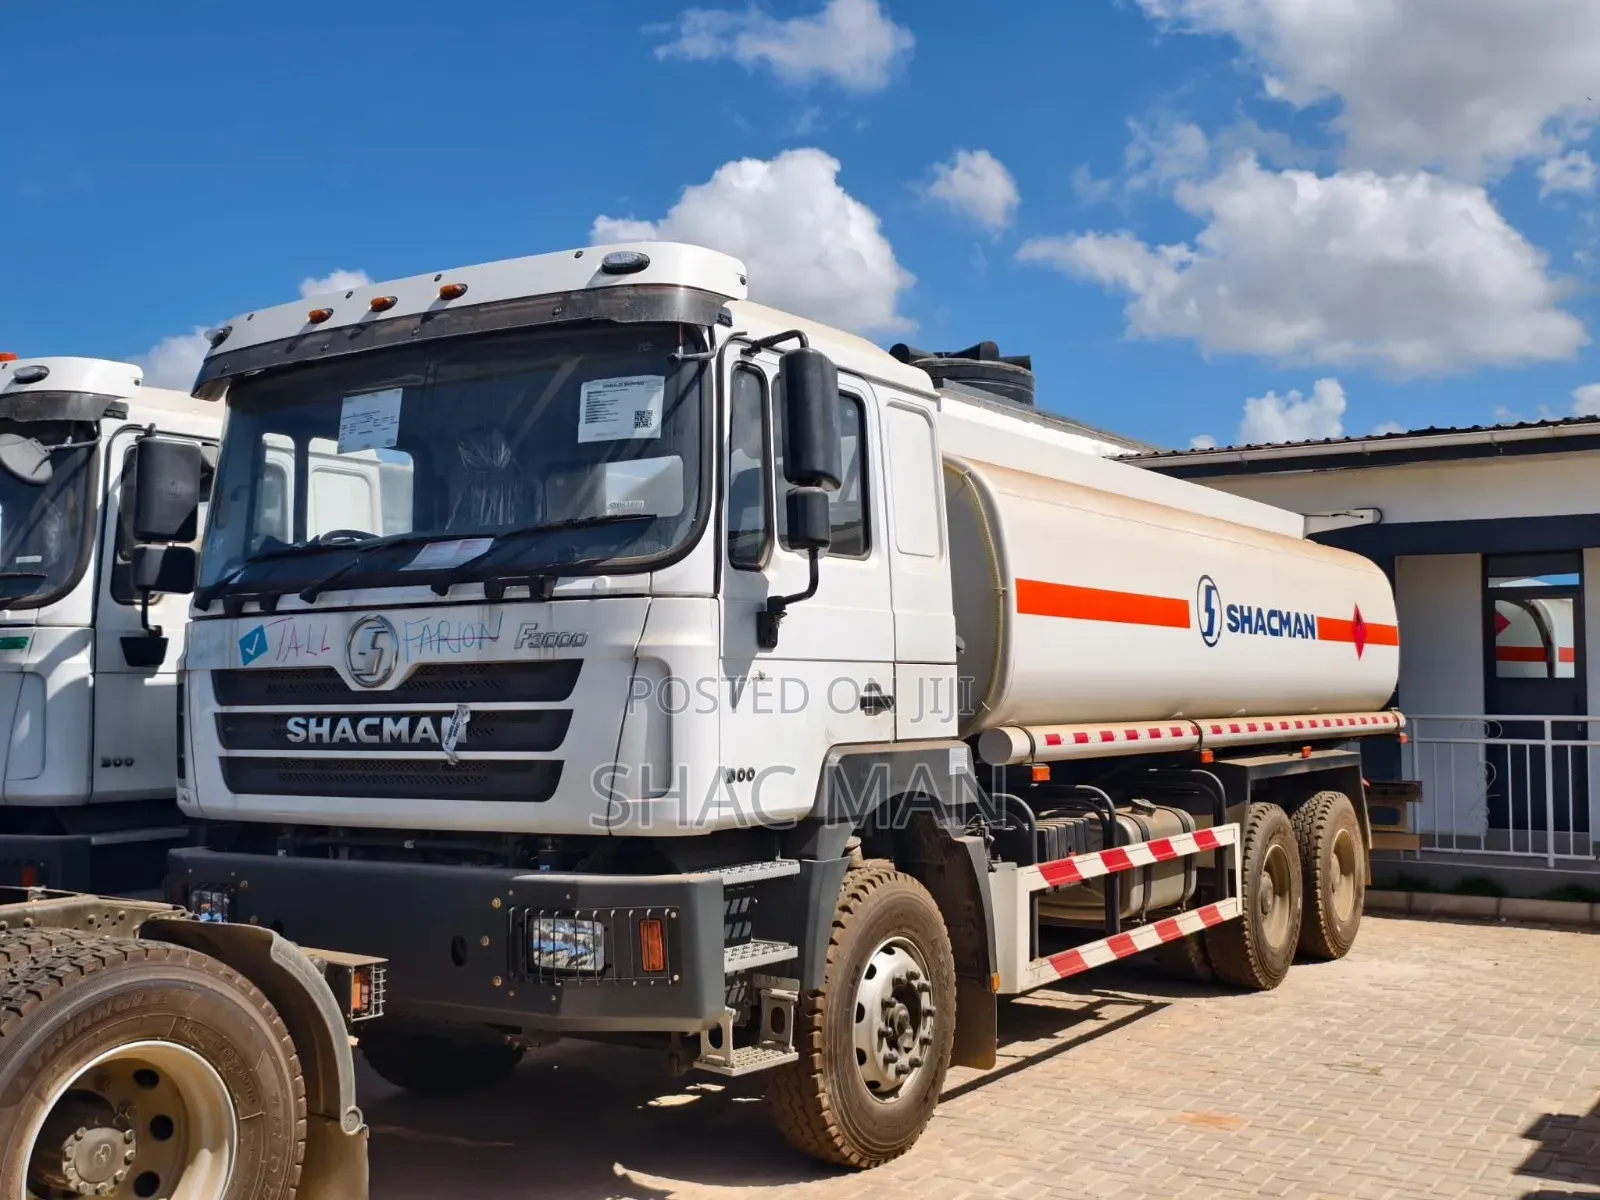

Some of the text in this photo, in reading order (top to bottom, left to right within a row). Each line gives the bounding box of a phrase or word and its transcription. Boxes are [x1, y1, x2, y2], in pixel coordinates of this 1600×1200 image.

[514, 622, 588, 650] F3000
[1226, 603, 1316, 640] SHACMAN
[286, 715, 467, 744] SHACMAN
